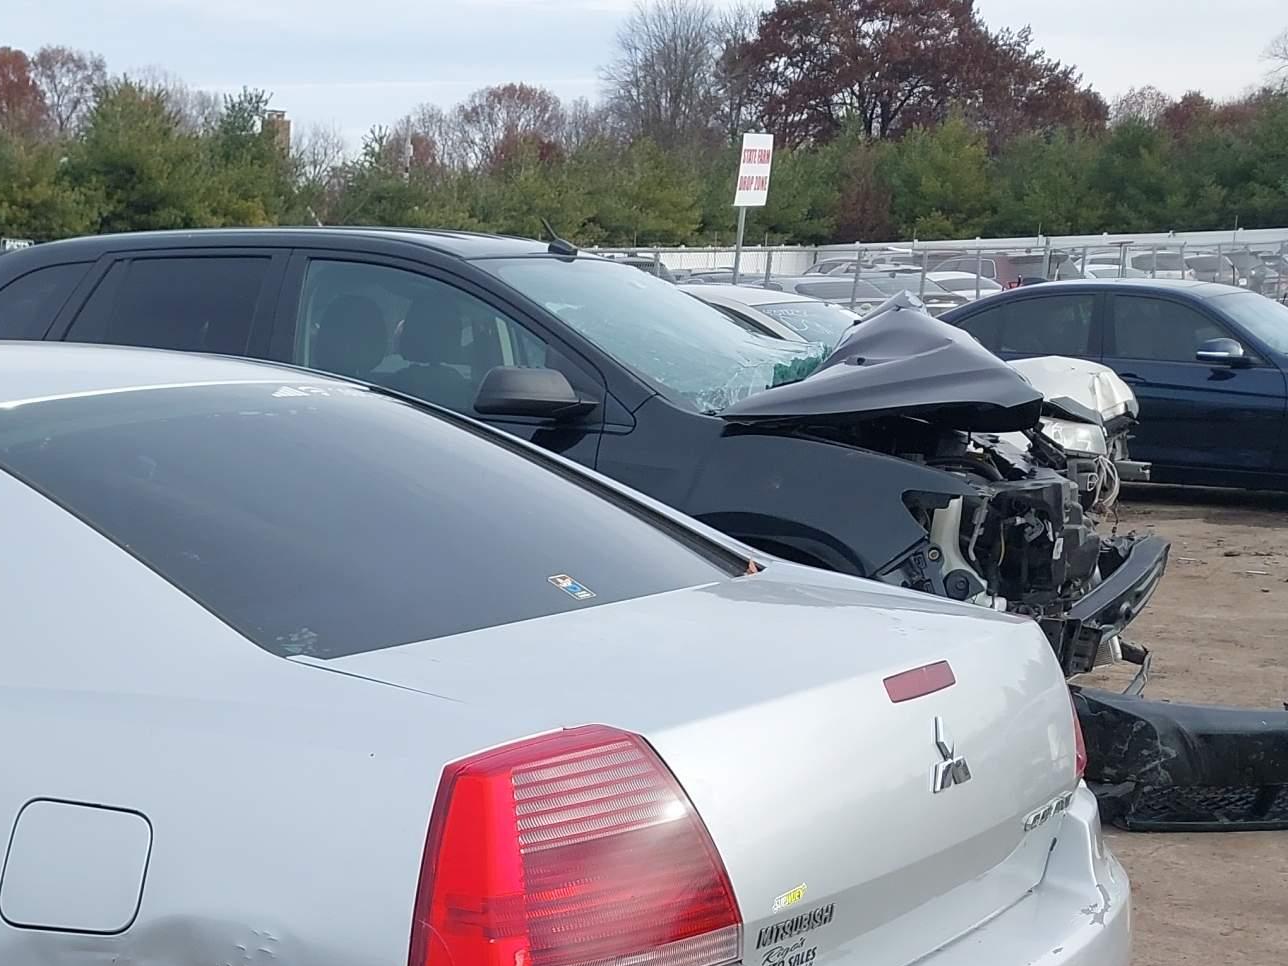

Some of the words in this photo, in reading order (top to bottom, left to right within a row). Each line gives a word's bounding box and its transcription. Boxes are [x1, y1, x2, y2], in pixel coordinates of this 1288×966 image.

[743, 149, 757, 164] STATE
[739, 176, 754, 191] DROP
[754, 176, 768, 191] ZONE
